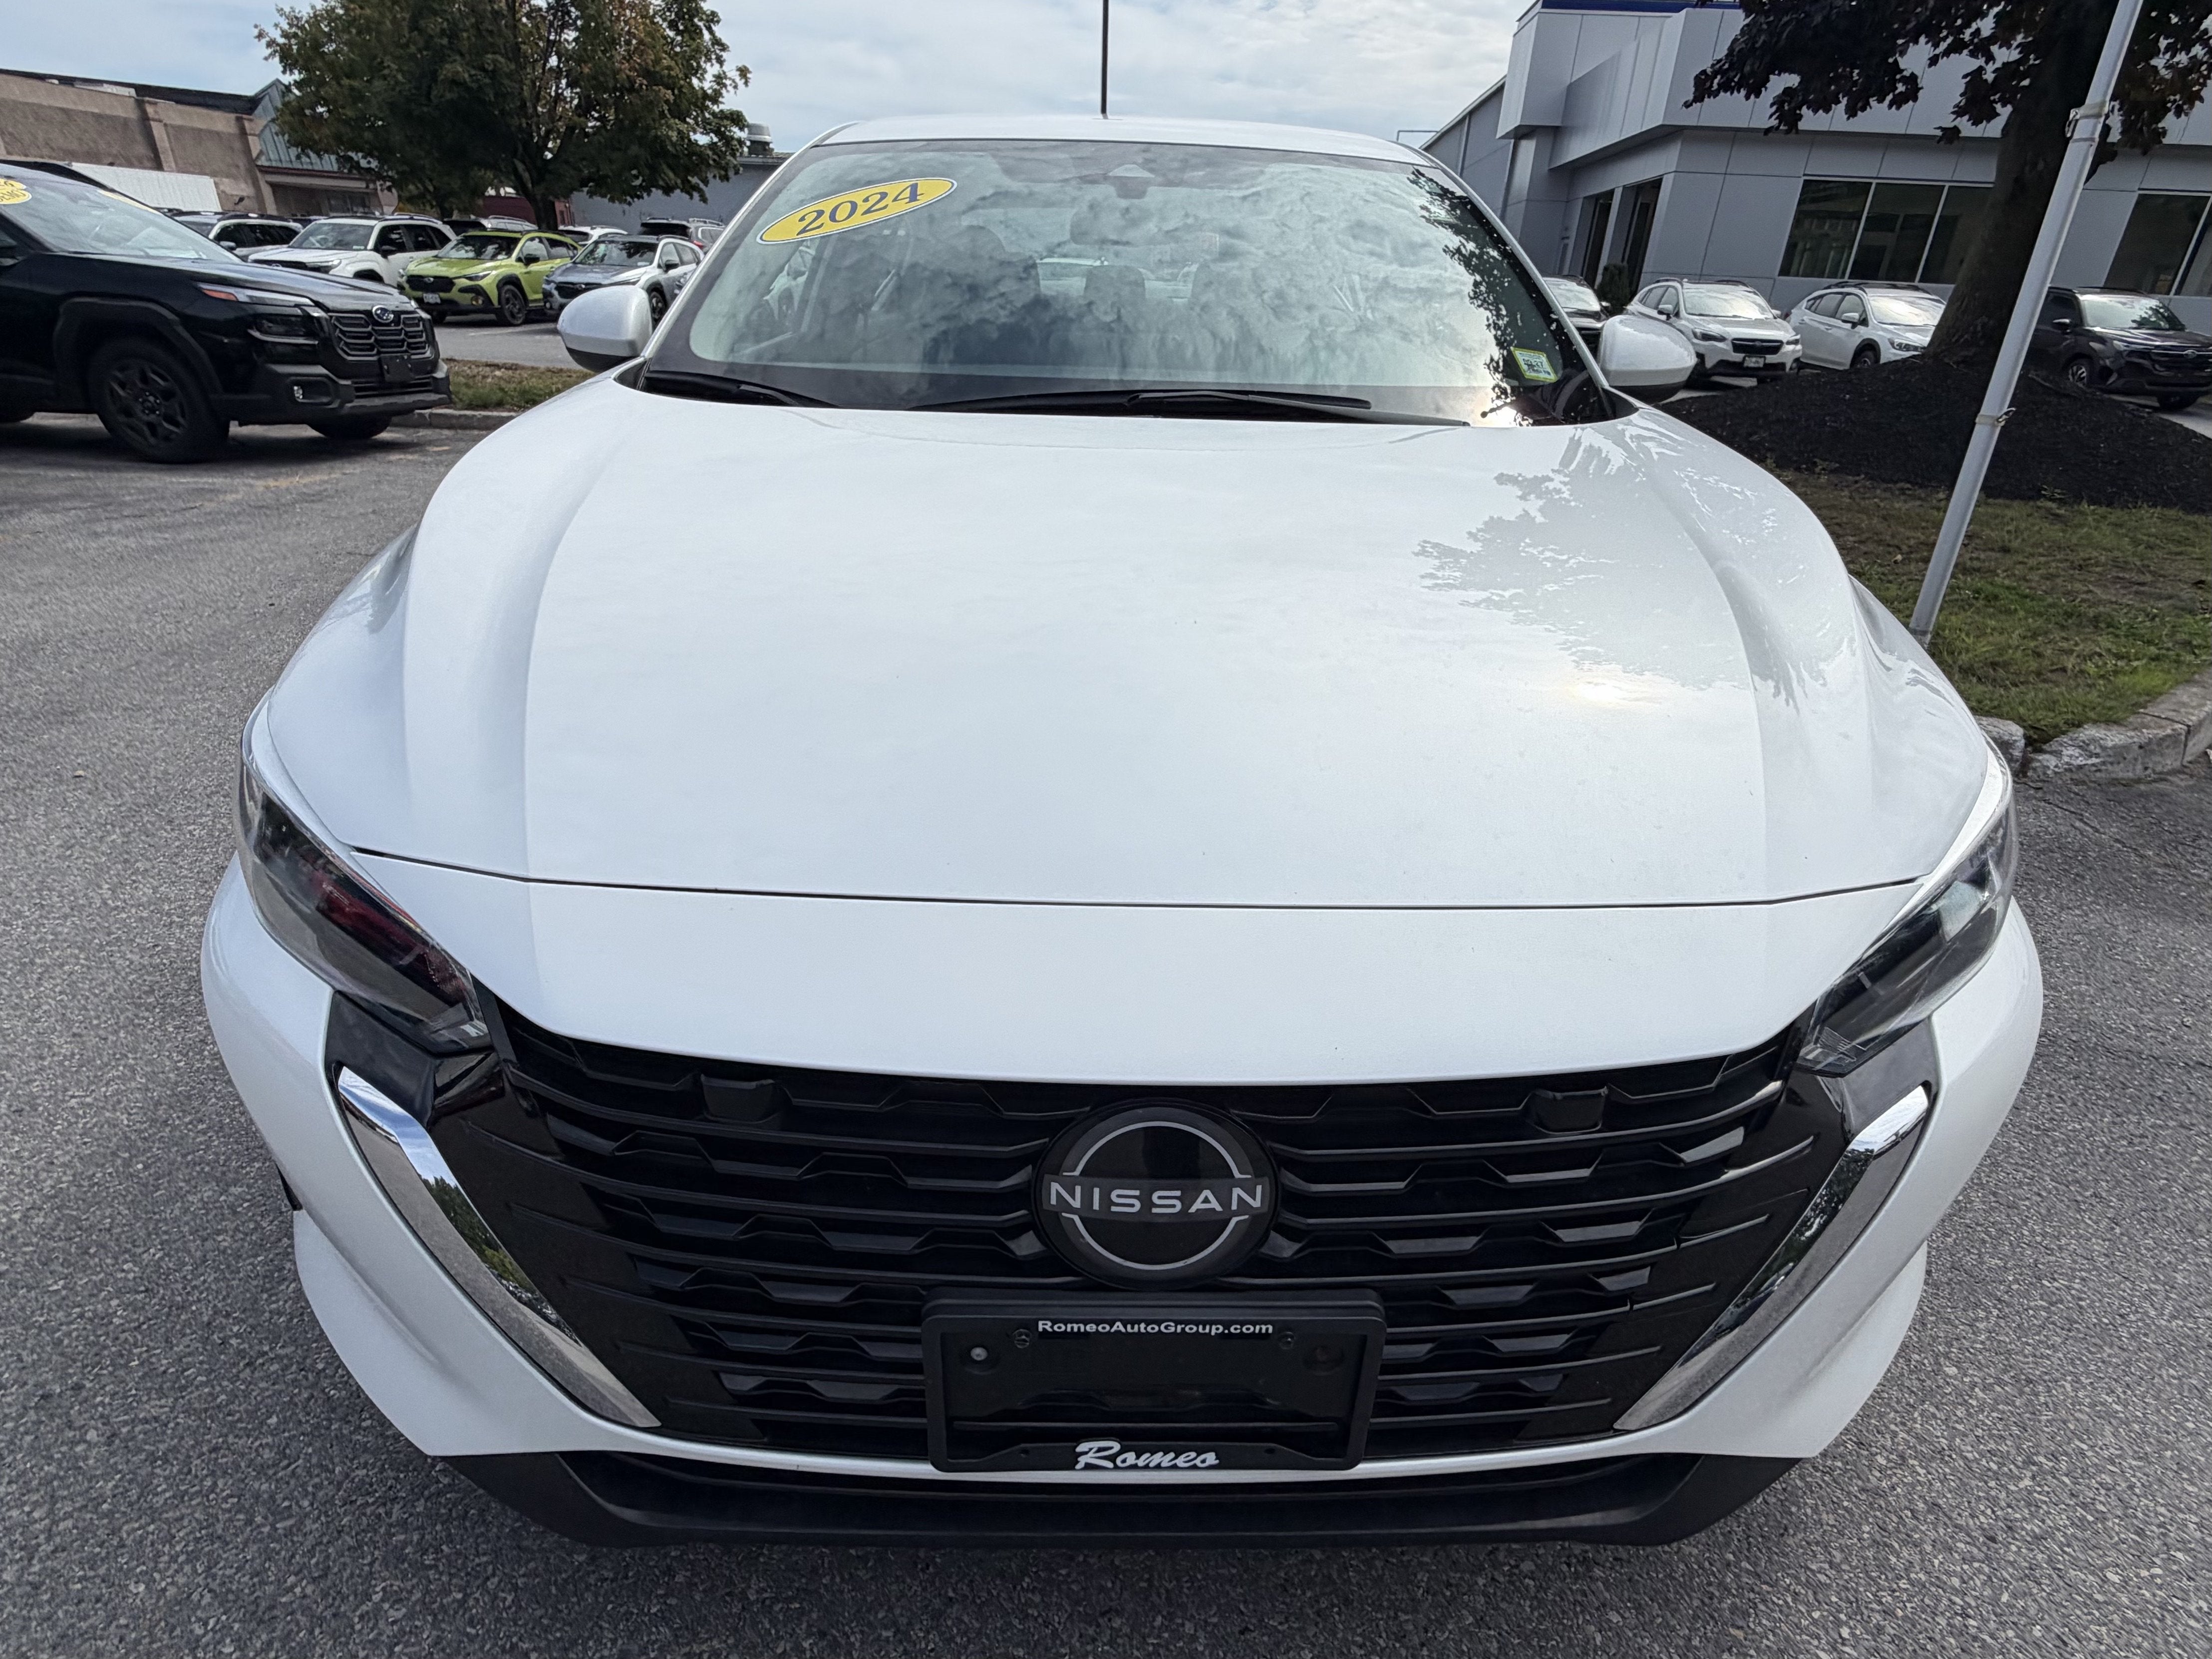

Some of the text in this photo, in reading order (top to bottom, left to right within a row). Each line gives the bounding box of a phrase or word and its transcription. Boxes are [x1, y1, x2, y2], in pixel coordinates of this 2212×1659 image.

[796, 182, 925, 236] 2024
[1050, 1181, 1263, 1214] NISSAN
[1038, 1321, 1273, 1335] RomeoAutoGroup.com
[1075, 1441, 1220, 1469] Romeo
